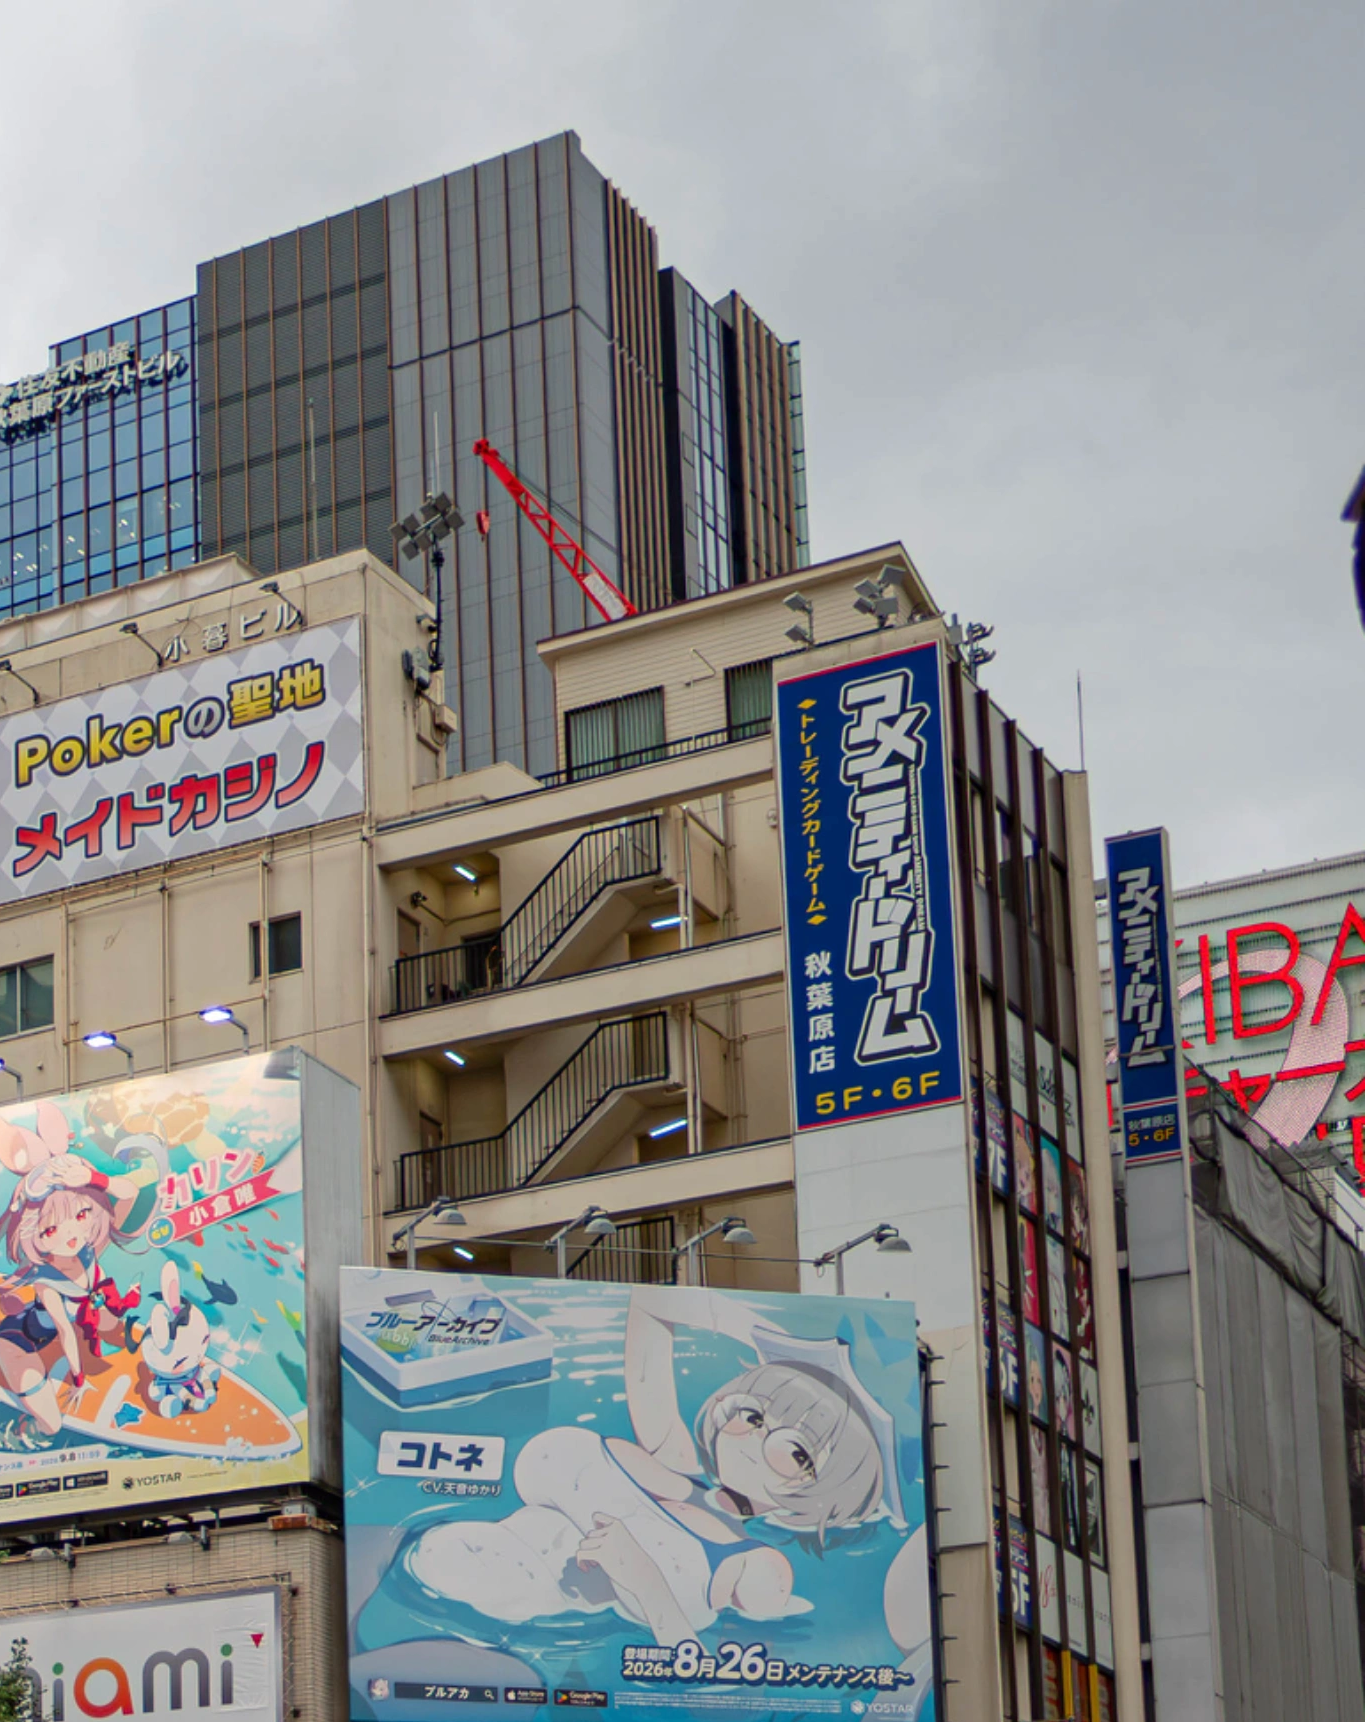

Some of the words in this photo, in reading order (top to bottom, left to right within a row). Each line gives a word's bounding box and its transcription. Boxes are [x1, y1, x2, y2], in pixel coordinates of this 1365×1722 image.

[164, 603, 303, 663] 小暮ビル
[14, 658, 325, 787] Pokerの聖地
[11, 740, 325, 878] メイドカジノ
[800, 713, 826, 914] トレーディングカードゲーム
[840, 668, 941, 1066] アメニティドリーム
[1117, 867, 1167, 1068] アメニティドリーム
[1175, 902, 1365, 1048] IBA
[804, 951, 836, 1075] 秋葉原店
[161, 1149, 254, 1212] カリン
[188, 1184, 256, 1227] 小倉唯
[365, 1310, 503, 1335] ブルーアーカイブ
[137, 1471, 182, 1487] YOSTAR
[396, 1441, 485, 1472] コトネ
[424, 1685, 470, 1700] ブルアカ
[867, 1703, 914, 1714] YOSTAR
